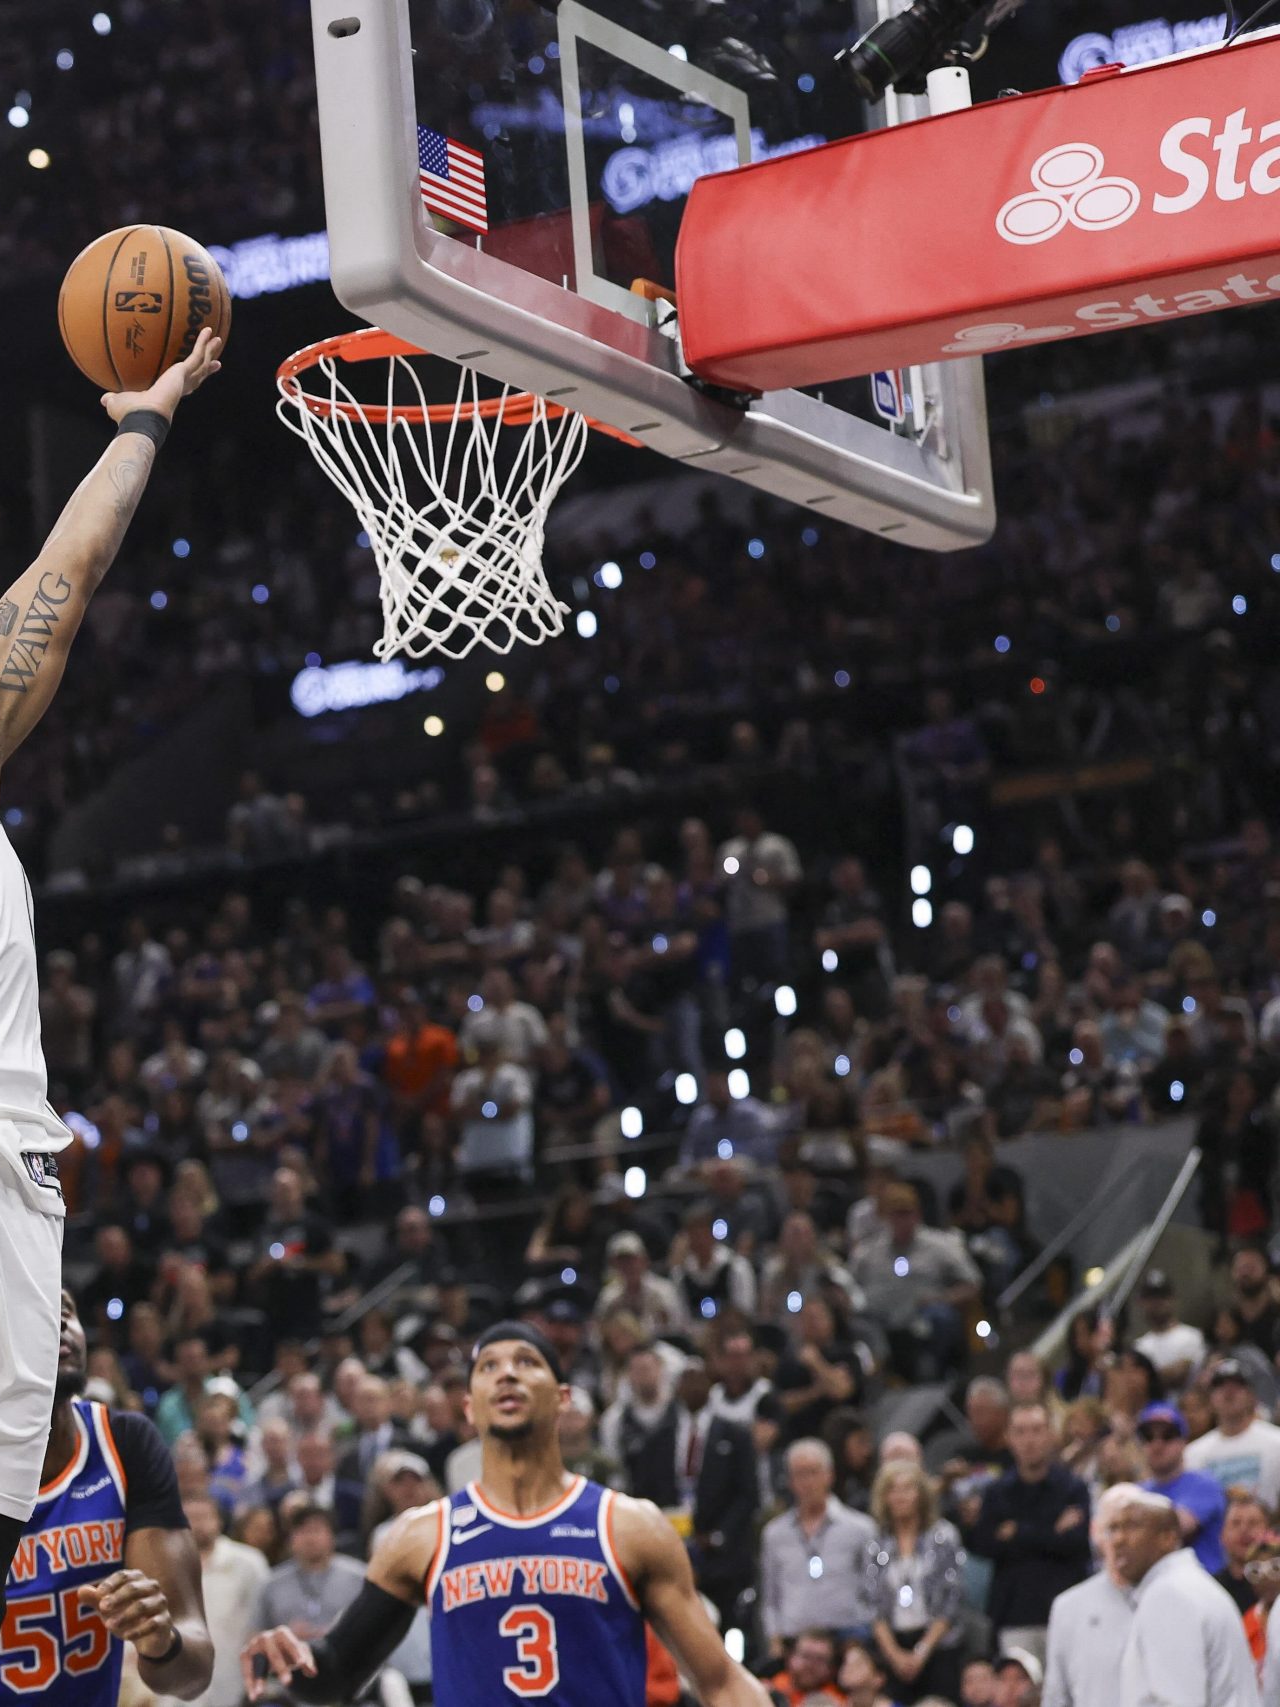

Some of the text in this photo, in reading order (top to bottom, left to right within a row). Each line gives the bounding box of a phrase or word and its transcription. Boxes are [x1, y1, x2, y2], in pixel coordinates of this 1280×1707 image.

[1153, 107, 1280, 214] Sta
[1075, 274, 1280, 328] Stat
[440, 1555, 609, 1613] NEW YORK
[499, 1603, 560, 1697] 3
